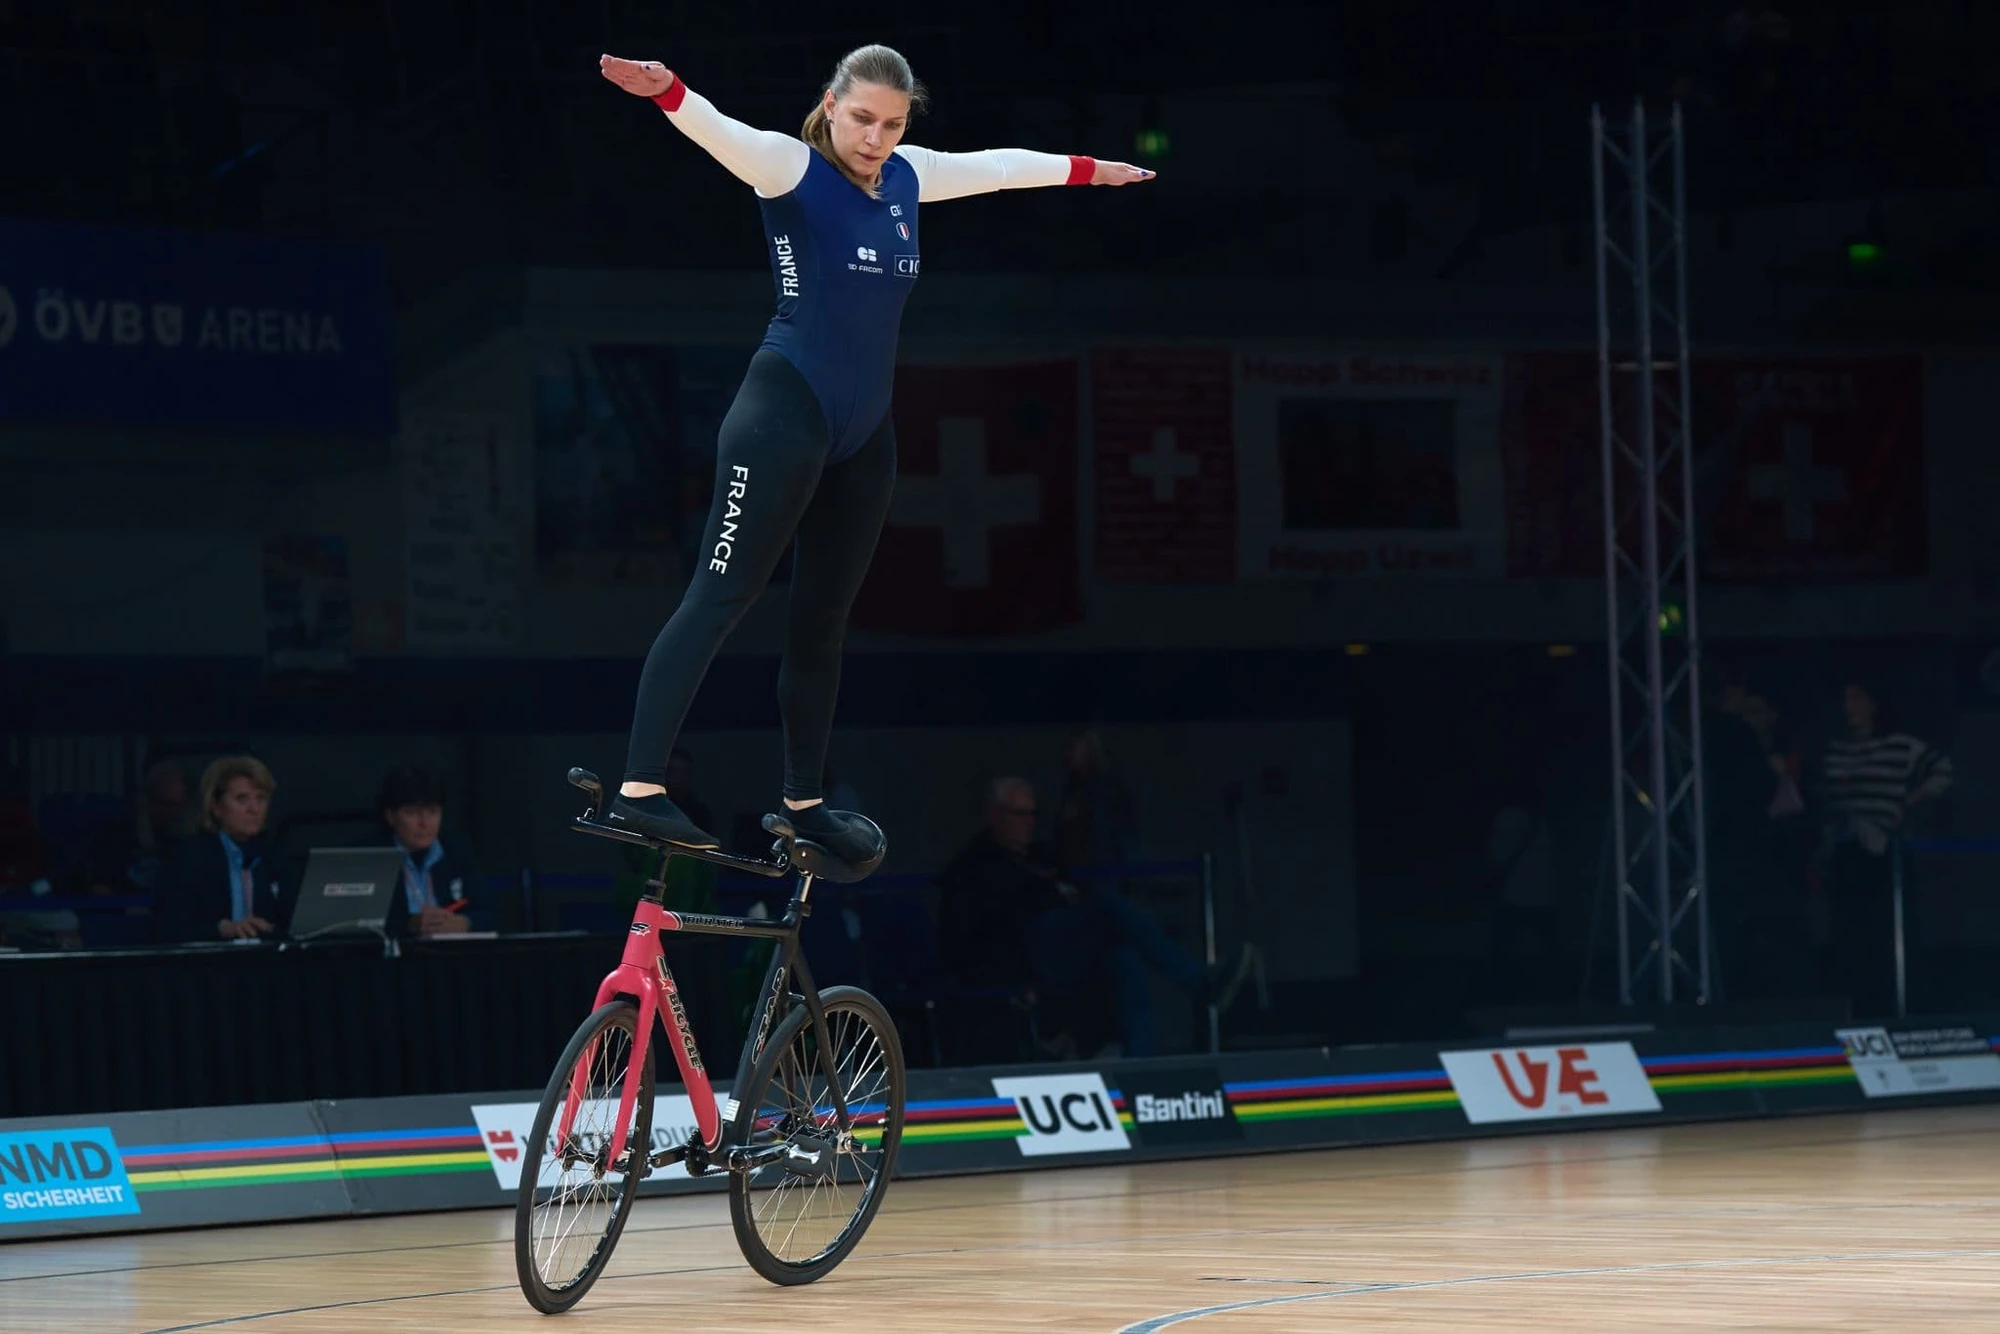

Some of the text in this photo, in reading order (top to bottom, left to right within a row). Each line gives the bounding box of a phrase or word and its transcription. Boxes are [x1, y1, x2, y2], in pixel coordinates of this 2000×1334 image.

[774, 234, 799, 297] FRANCE
[35, 287, 343, 354] ÖVB ARENA
[708, 465, 749, 575] FRANCE
[1019, 1092, 1114, 1135] UCI
[1135, 1089, 1225, 1123] Santini
[3, 1184, 123, 1210] SICHERHEIT
